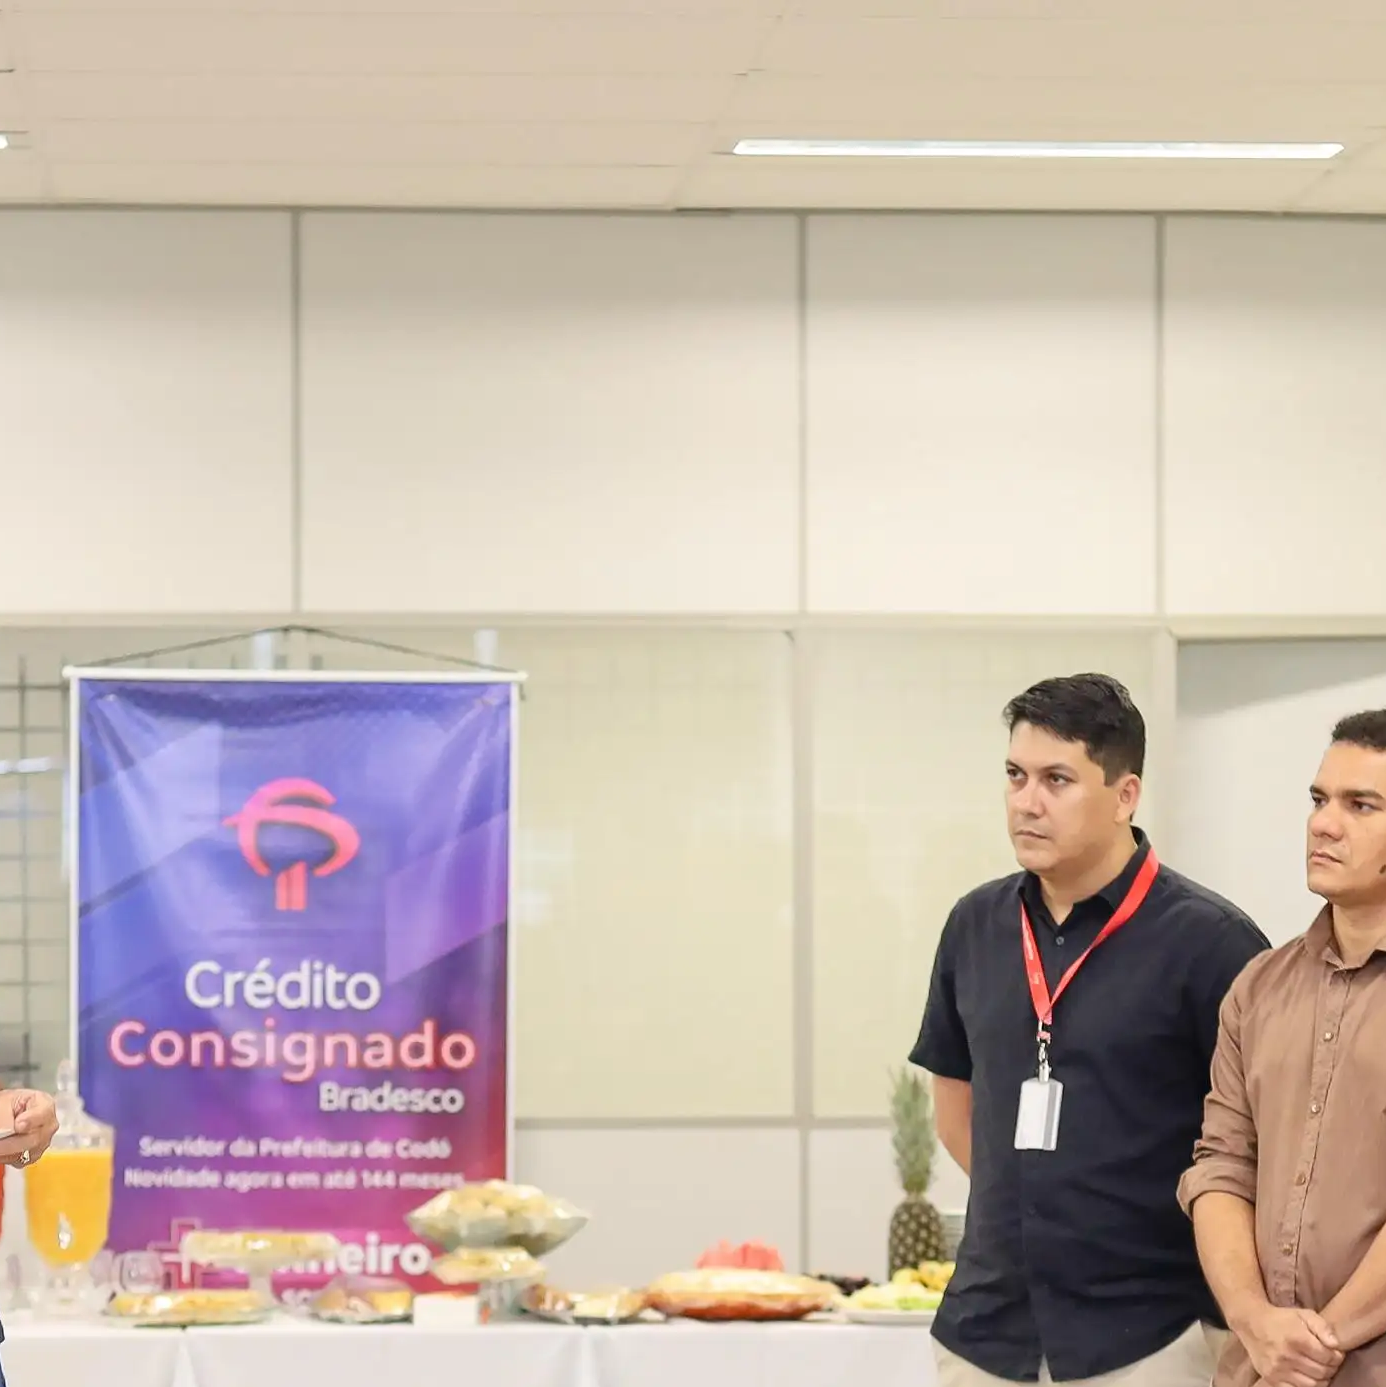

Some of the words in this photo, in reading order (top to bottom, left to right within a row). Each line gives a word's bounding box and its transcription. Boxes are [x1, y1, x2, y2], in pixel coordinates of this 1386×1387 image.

[185, 958, 381, 1011] Crédito
[110, 1017, 477, 1083] Consignado
[319, 1081, 465, 1114] Bradesco
[139, 1136, 225, 1158] Servidor
[229, 1137, 256, 1158] da
[259, 1137, 361, 1158] Prefeitura
[365, 1138, 392, 1158] de
[125, 1167, 221, 1188] Novidade
[224, 1171, 284, 1192] agora
[286, 1172, 320, 1188] em
[399, 1171, 463, 1188] meses
